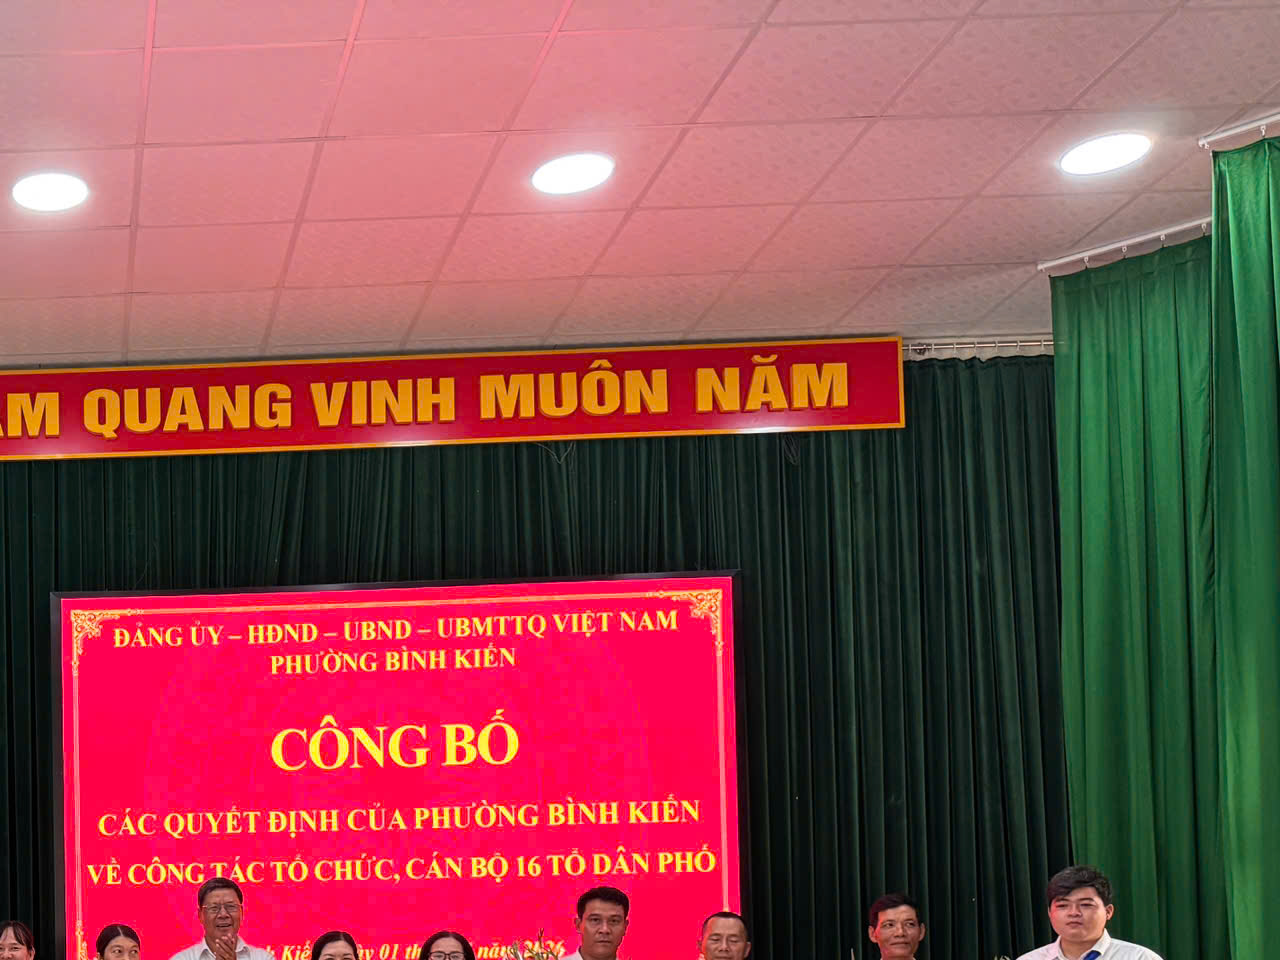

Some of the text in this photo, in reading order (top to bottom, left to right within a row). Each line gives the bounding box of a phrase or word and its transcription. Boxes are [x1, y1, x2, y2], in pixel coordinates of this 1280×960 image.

[84, 384, 291, 438] QUANG
[311, 378, 455, 426] VINH
[481, 360, 668, 418] MUÔN
[697, 355, 848, 411] NĂM
[114, 623, 182, 647] ĐẢNG
[191, 621, 223, 646] ỦY
[248, 624, 318, 644] HĐND
[344, 620, 411, 641] UBND
[438, 615, 546, 638] UBMTTQ
[552, 610, 613, 637] VIỆT
[620, 610, 677, 631] NAM
[271, 643, 514, 674] PHƯỜNG BÌNH KIẾN
[271, 709, 519, 770] CÔNG BỐ
[98, 794, 698, 838] CÁC QUYẾT ĐỊNH CỦA PHƯỜNG BÌNH KIẾN
[88, 844, 716, 884] VỀ CÔNG TÁC TỔ CHỨC, CÁN BỘ 16 TỔ DÂN PHỐ
[379, 944, 399, 960] 01
